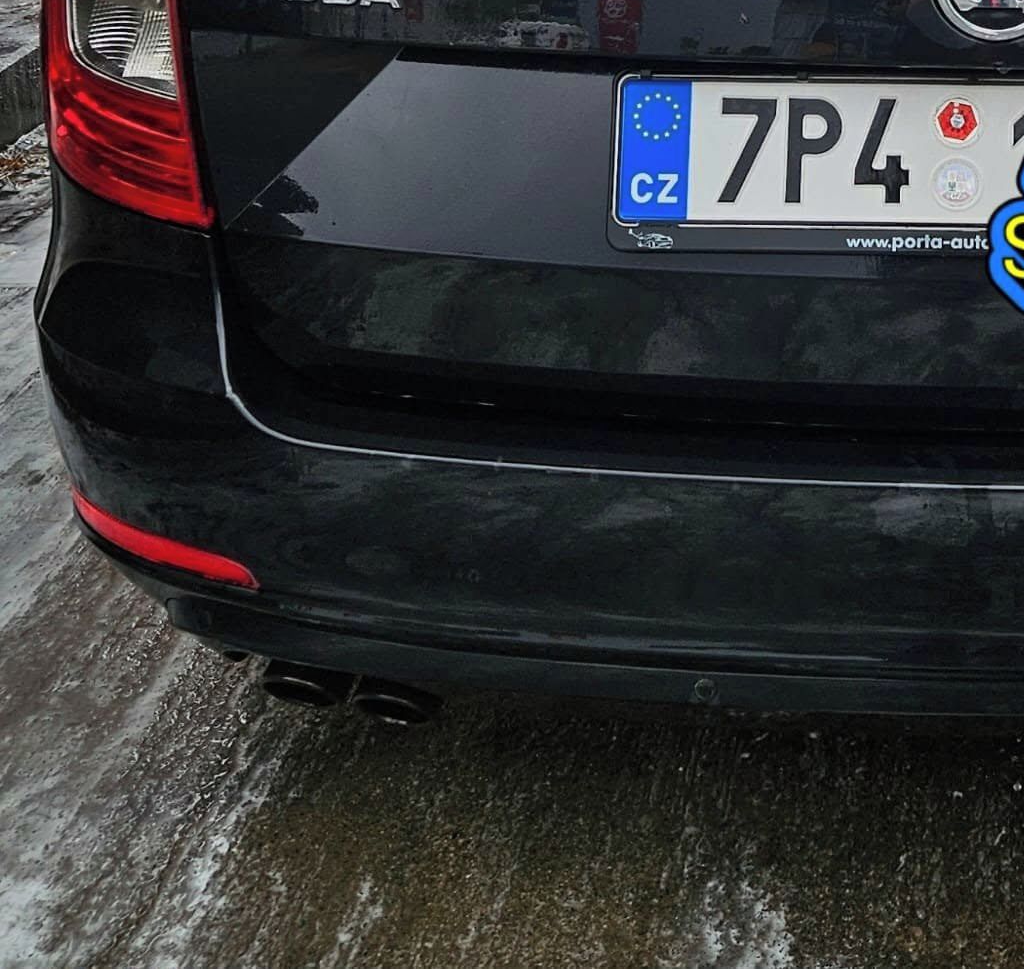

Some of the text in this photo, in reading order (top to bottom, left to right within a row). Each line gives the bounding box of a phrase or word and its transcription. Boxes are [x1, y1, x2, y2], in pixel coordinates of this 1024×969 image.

[717, 97, 910, 203] 7P4
[630, 172, 679, 204] CZ
[846, 234, 989, 252] www.porta-auto
